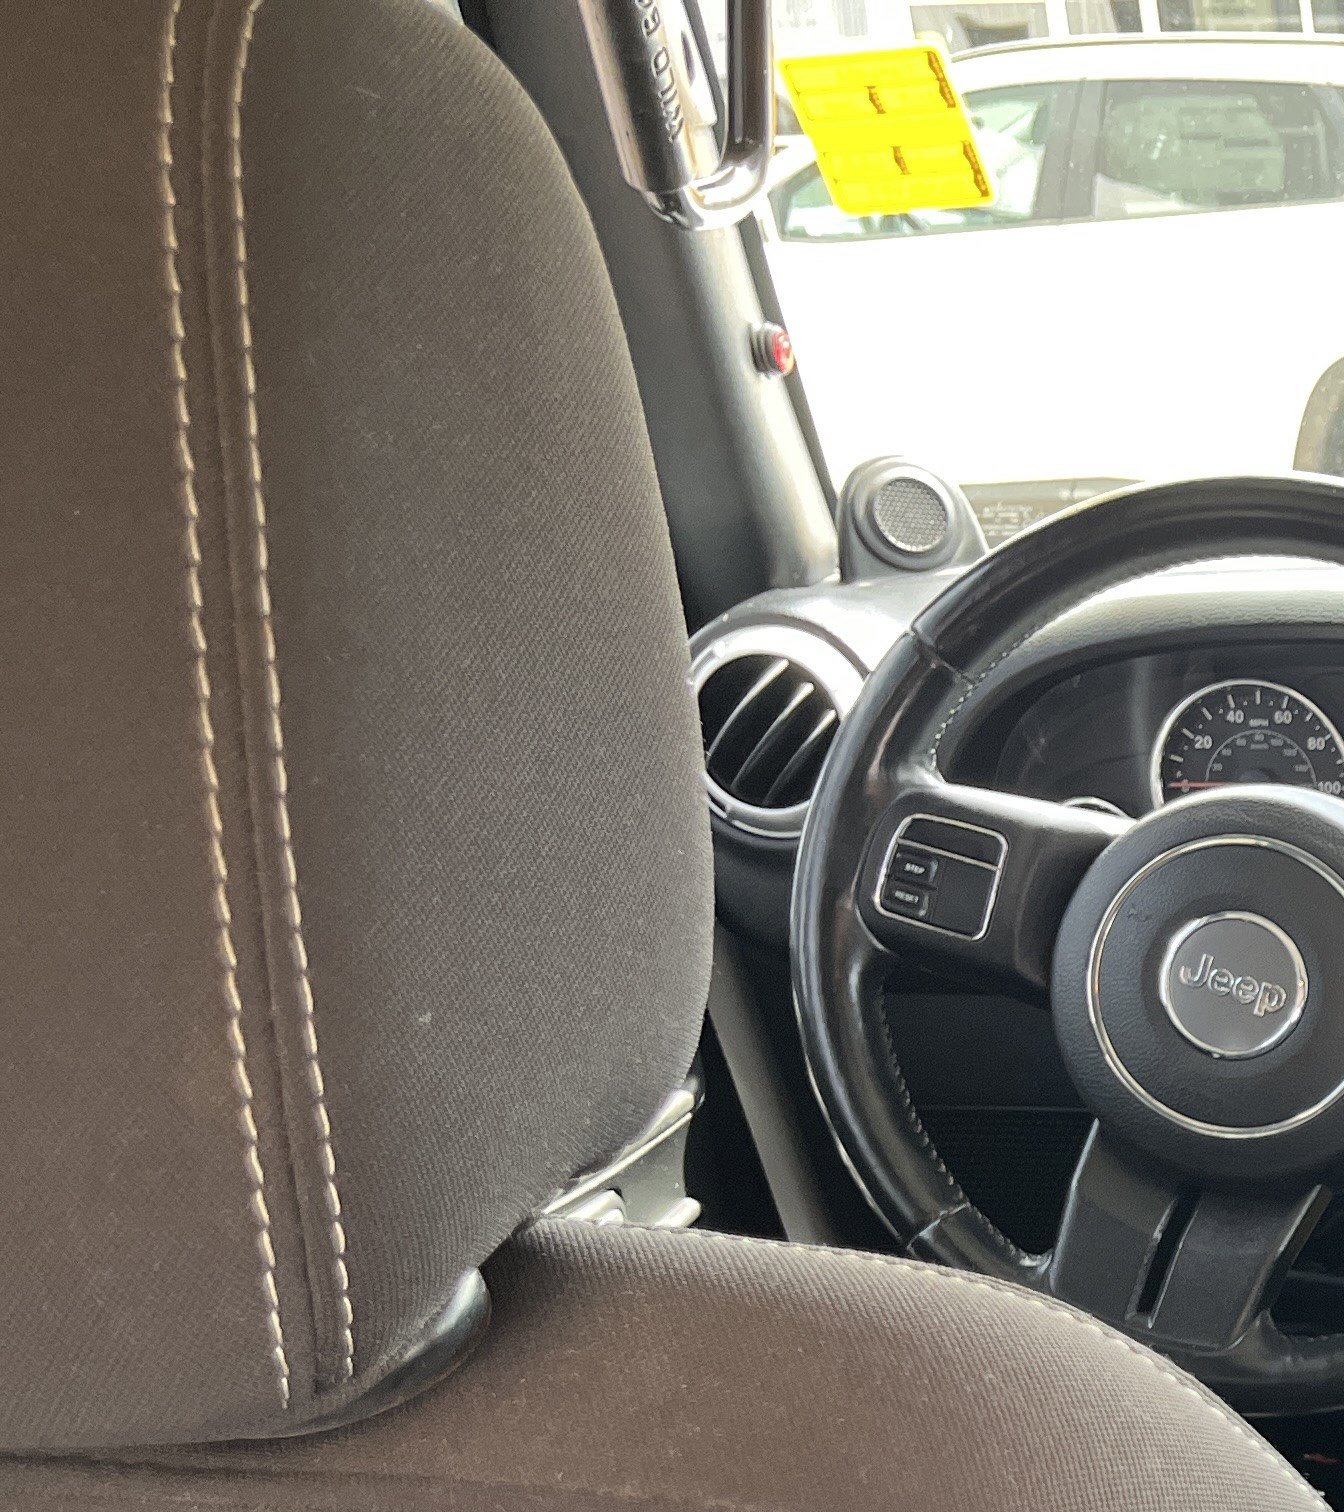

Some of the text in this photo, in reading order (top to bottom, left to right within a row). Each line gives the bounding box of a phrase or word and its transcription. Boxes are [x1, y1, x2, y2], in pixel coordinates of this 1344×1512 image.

[657, 46, 686, 143] WILD
[1226, 709, 1245, 724] 40
[1274, 709, 1293, 724] 60
[1194, 735, 1213, 749] 20
[1307, 736, 1326, 750] 80
[1318, 780, 1342, 795] 100
[1179, 953, 1267, 1017] Jeep
